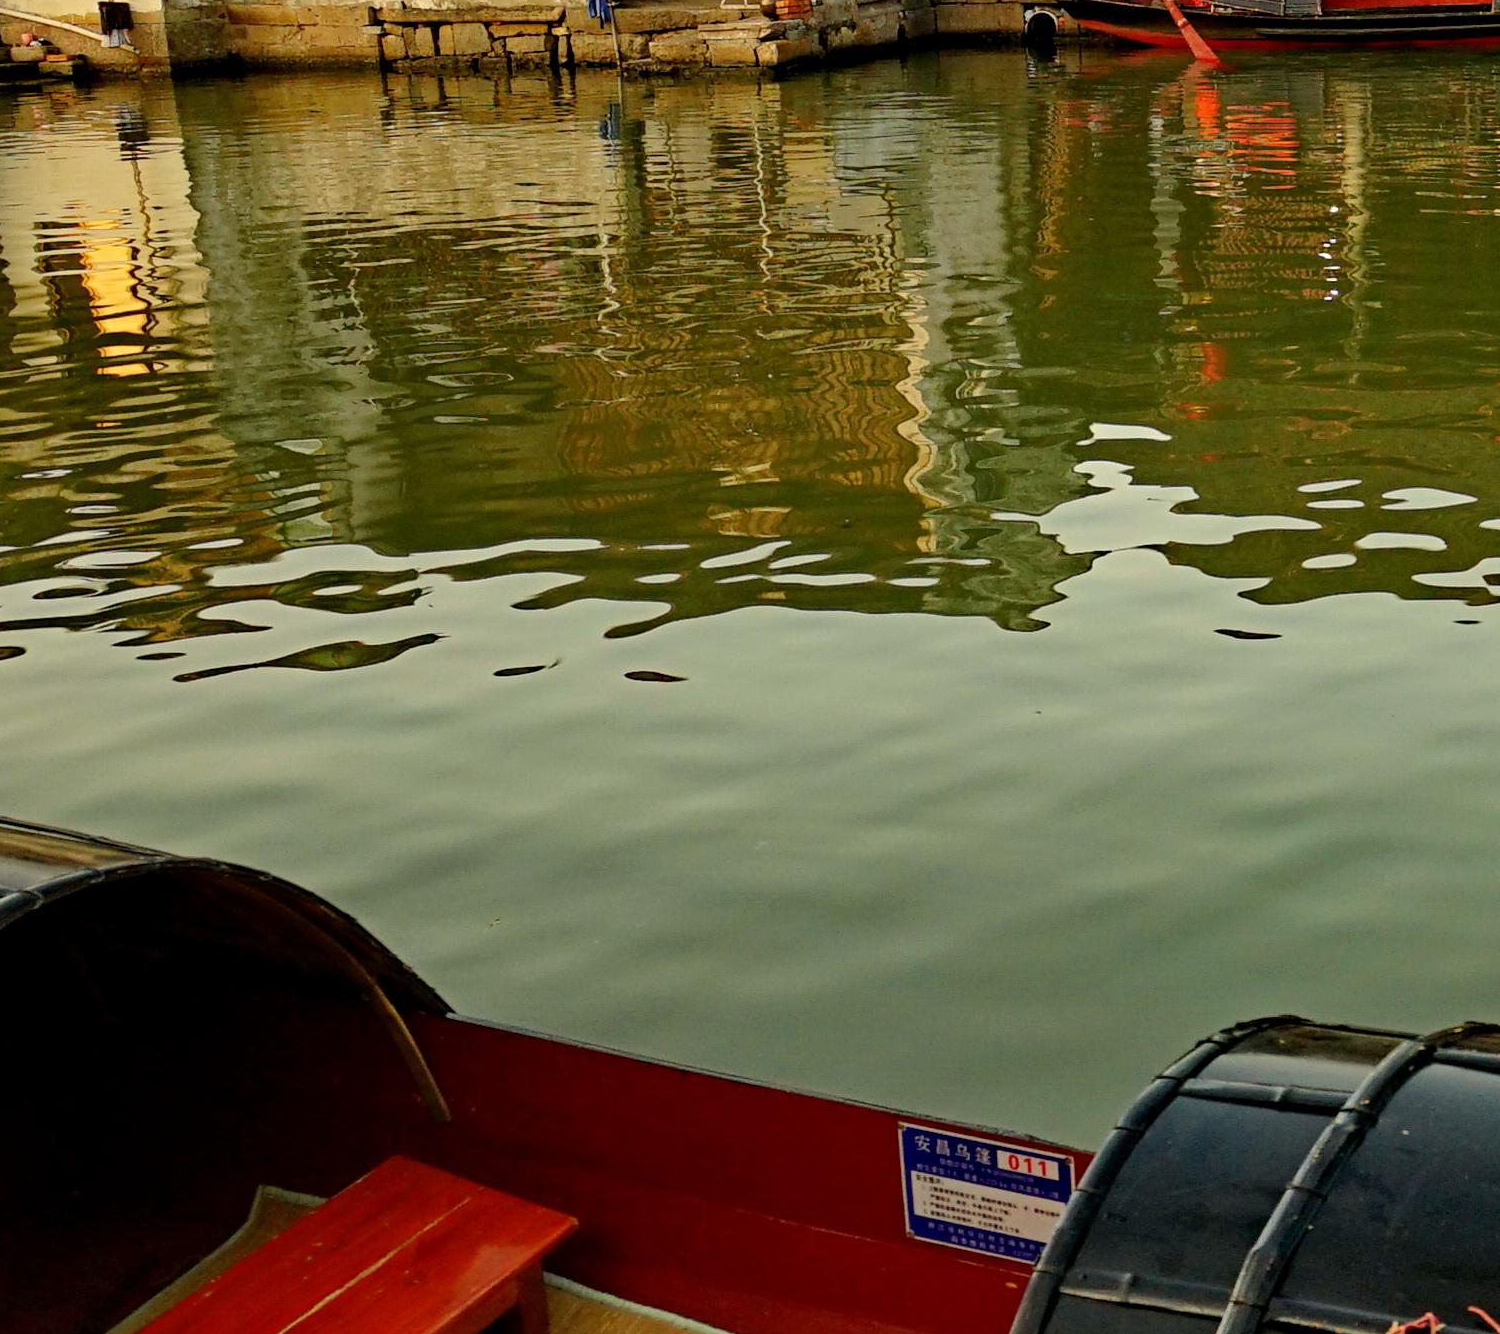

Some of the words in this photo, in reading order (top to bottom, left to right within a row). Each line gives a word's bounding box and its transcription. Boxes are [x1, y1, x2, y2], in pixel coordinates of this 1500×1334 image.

[914, 1134, 992, 1166] 安昌乌篷
[1008, 1154, 1049, 1177] 011
